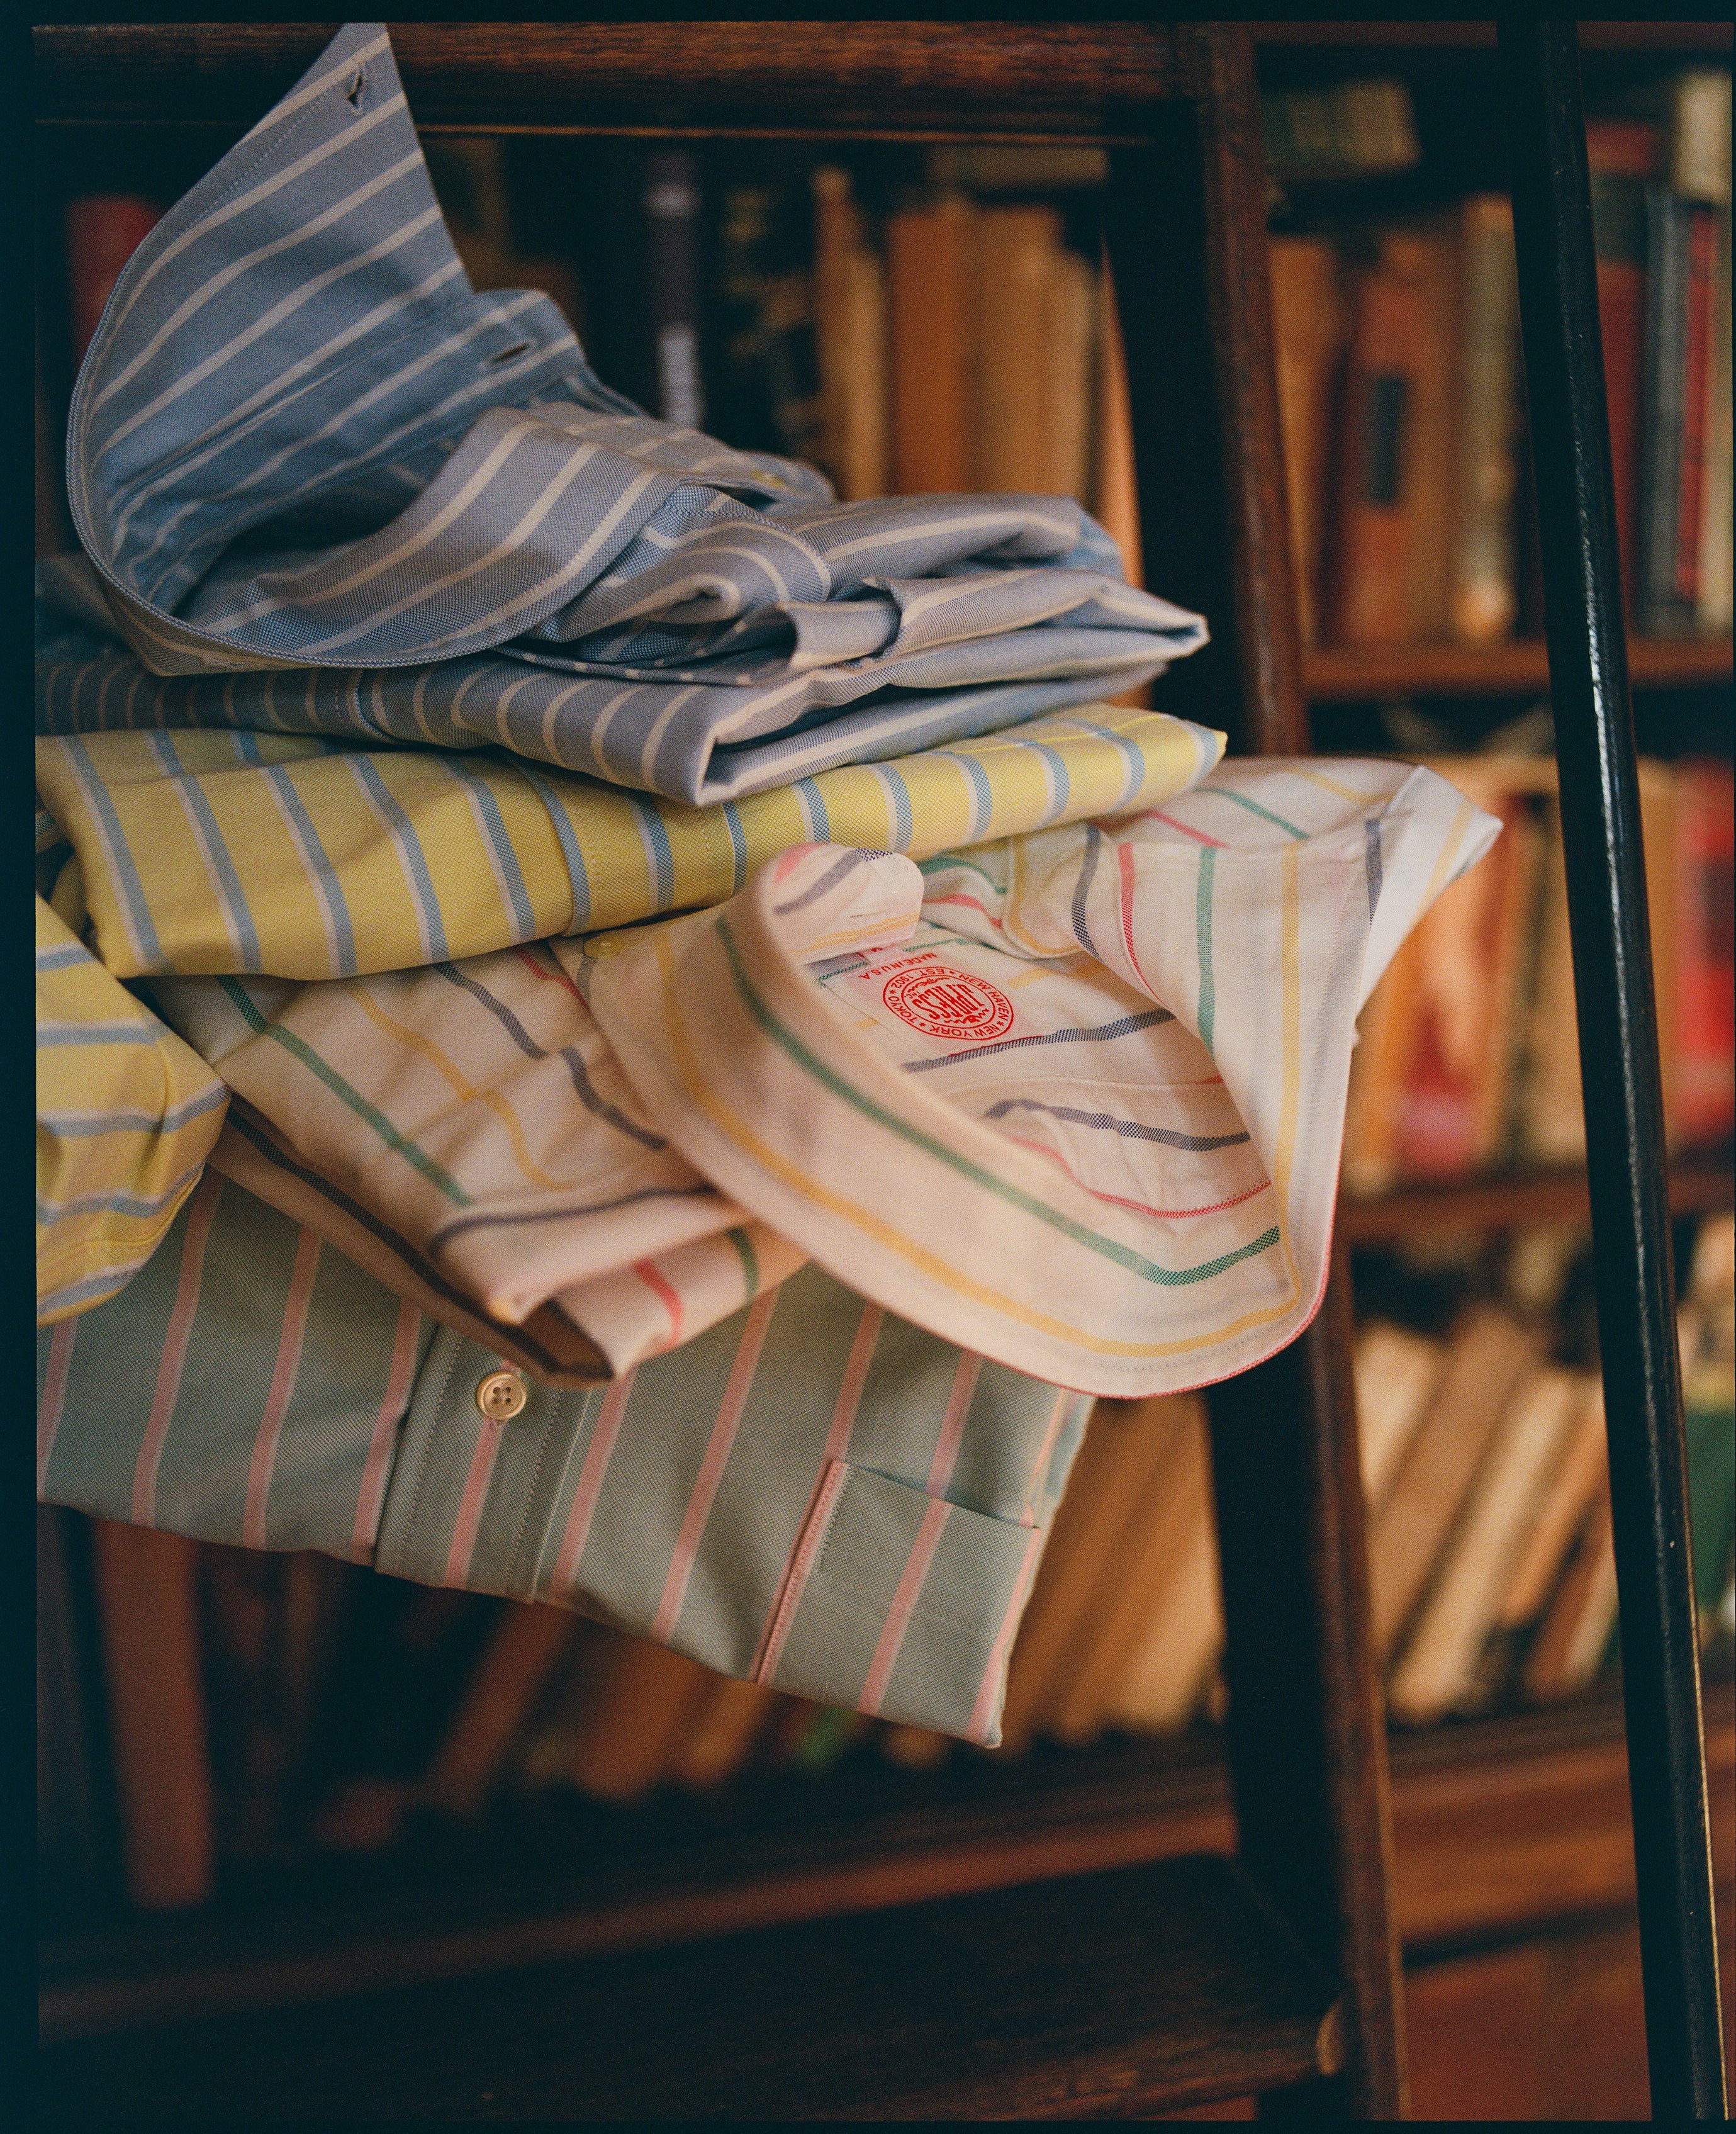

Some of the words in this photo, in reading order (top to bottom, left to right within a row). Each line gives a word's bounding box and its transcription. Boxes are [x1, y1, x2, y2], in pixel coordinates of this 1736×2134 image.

[890, 961, 904, 969] IN
[904, 953, 937, 965] MADE
[914, 969, 945, 977] EST.
[890, 974, 914, 989] 1902
[958, 974, 992, 990] NEW
[988, 991, 1009, 1021] HAVEN
[888, 996, 918, 1023] TOKYO
[929, 1025, 973, 1038] YORK
[973, 1023, 1000, 1037] NEW
